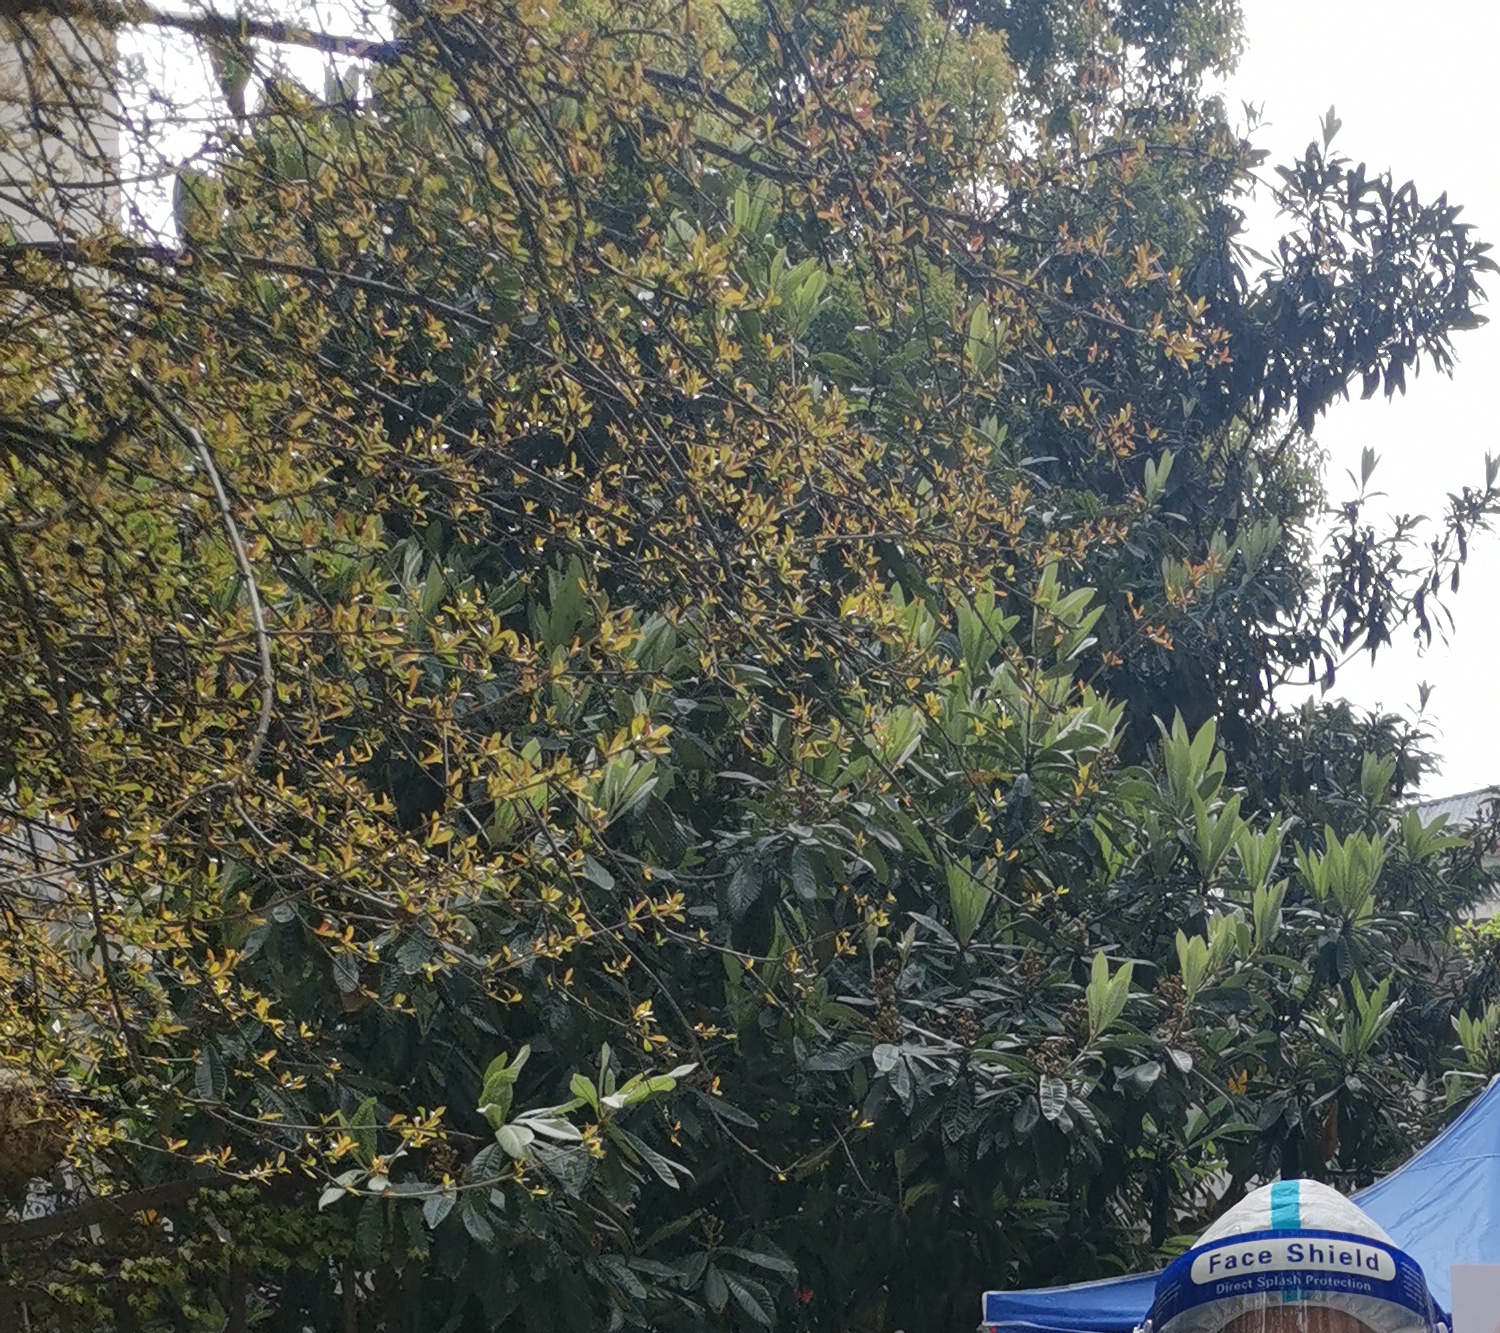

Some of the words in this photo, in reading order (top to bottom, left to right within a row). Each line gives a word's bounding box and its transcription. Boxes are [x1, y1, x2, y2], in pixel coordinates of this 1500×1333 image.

[1209, 1248, 1272, 1274] Face
[1286, 1243, 1379, 1271] Shield
[1216, 1278, 1252, 1295] Direct
[1257, 1275, 1301, 1289] Splash
[1306, 1275, 1371, 1292] Protection
